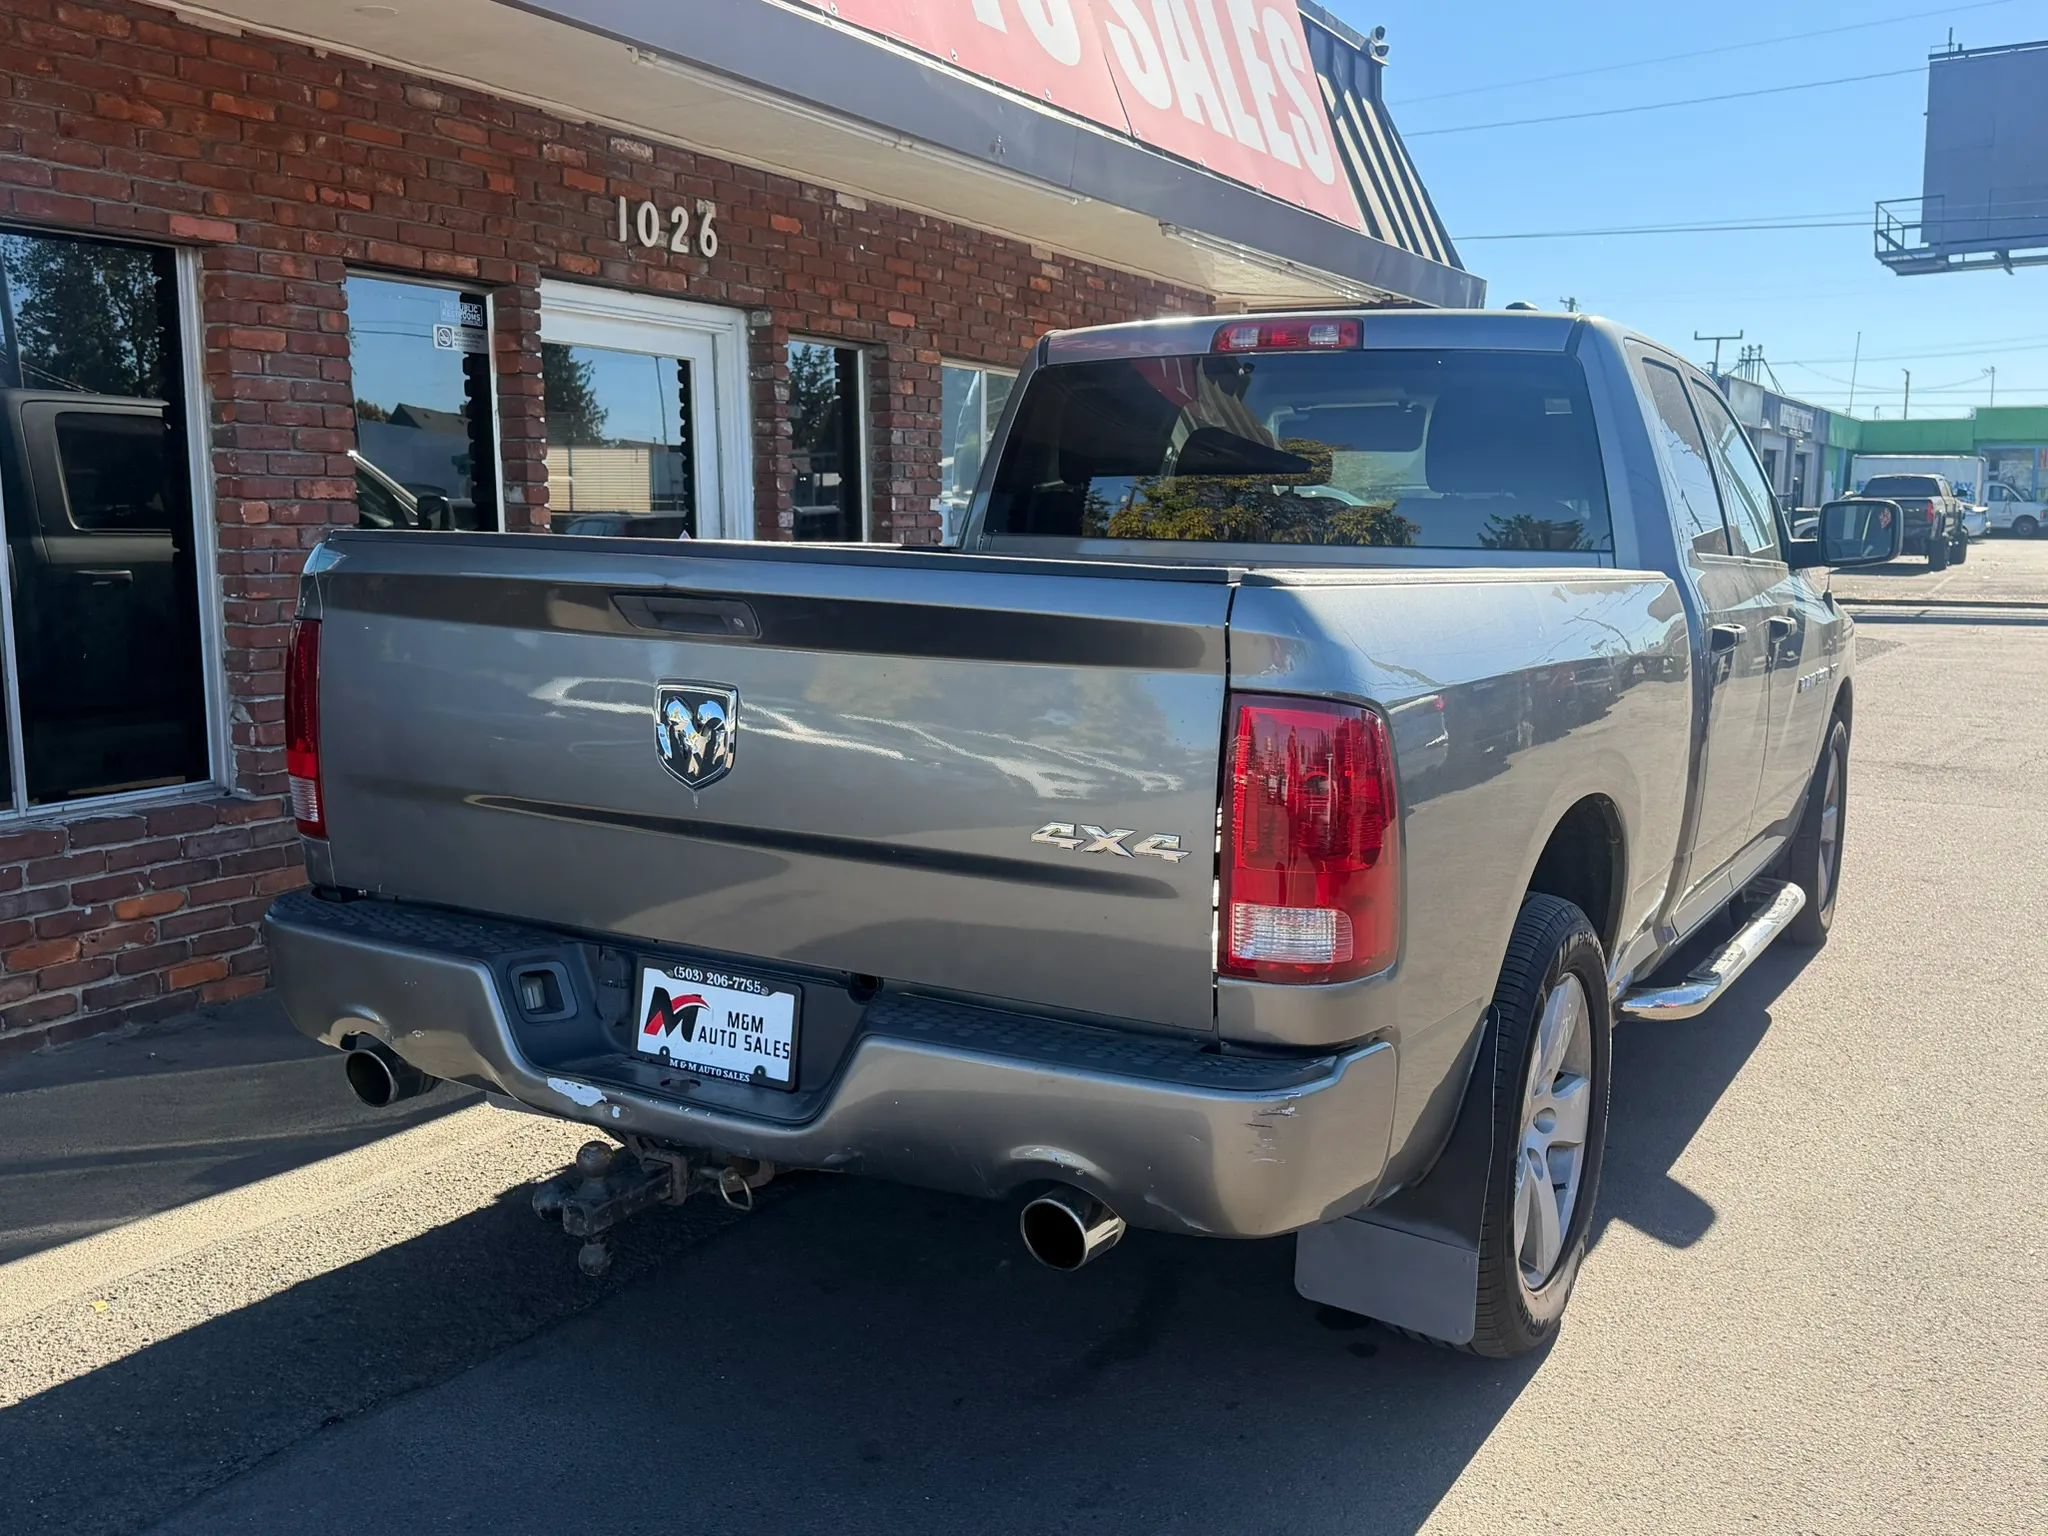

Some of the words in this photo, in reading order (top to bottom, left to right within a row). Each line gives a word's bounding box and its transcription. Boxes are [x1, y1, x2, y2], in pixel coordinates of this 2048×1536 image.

[1104, 0, 1335, 185] SALES
[618, 196, 718, 257] 1026
[674, 966, 704, 982] (503)
[727, 1011, 764, 1034] M&M
[698, 1026, 737, 1049] AUTO
[743, 1034, 790, 1060] SALES
[669, 1059, 678, 1068] M
[688, 1062, 697, 1071] M
[698, 1065, 722, 1077] AUTO
[722, 1069, 750, 1083] SALES
